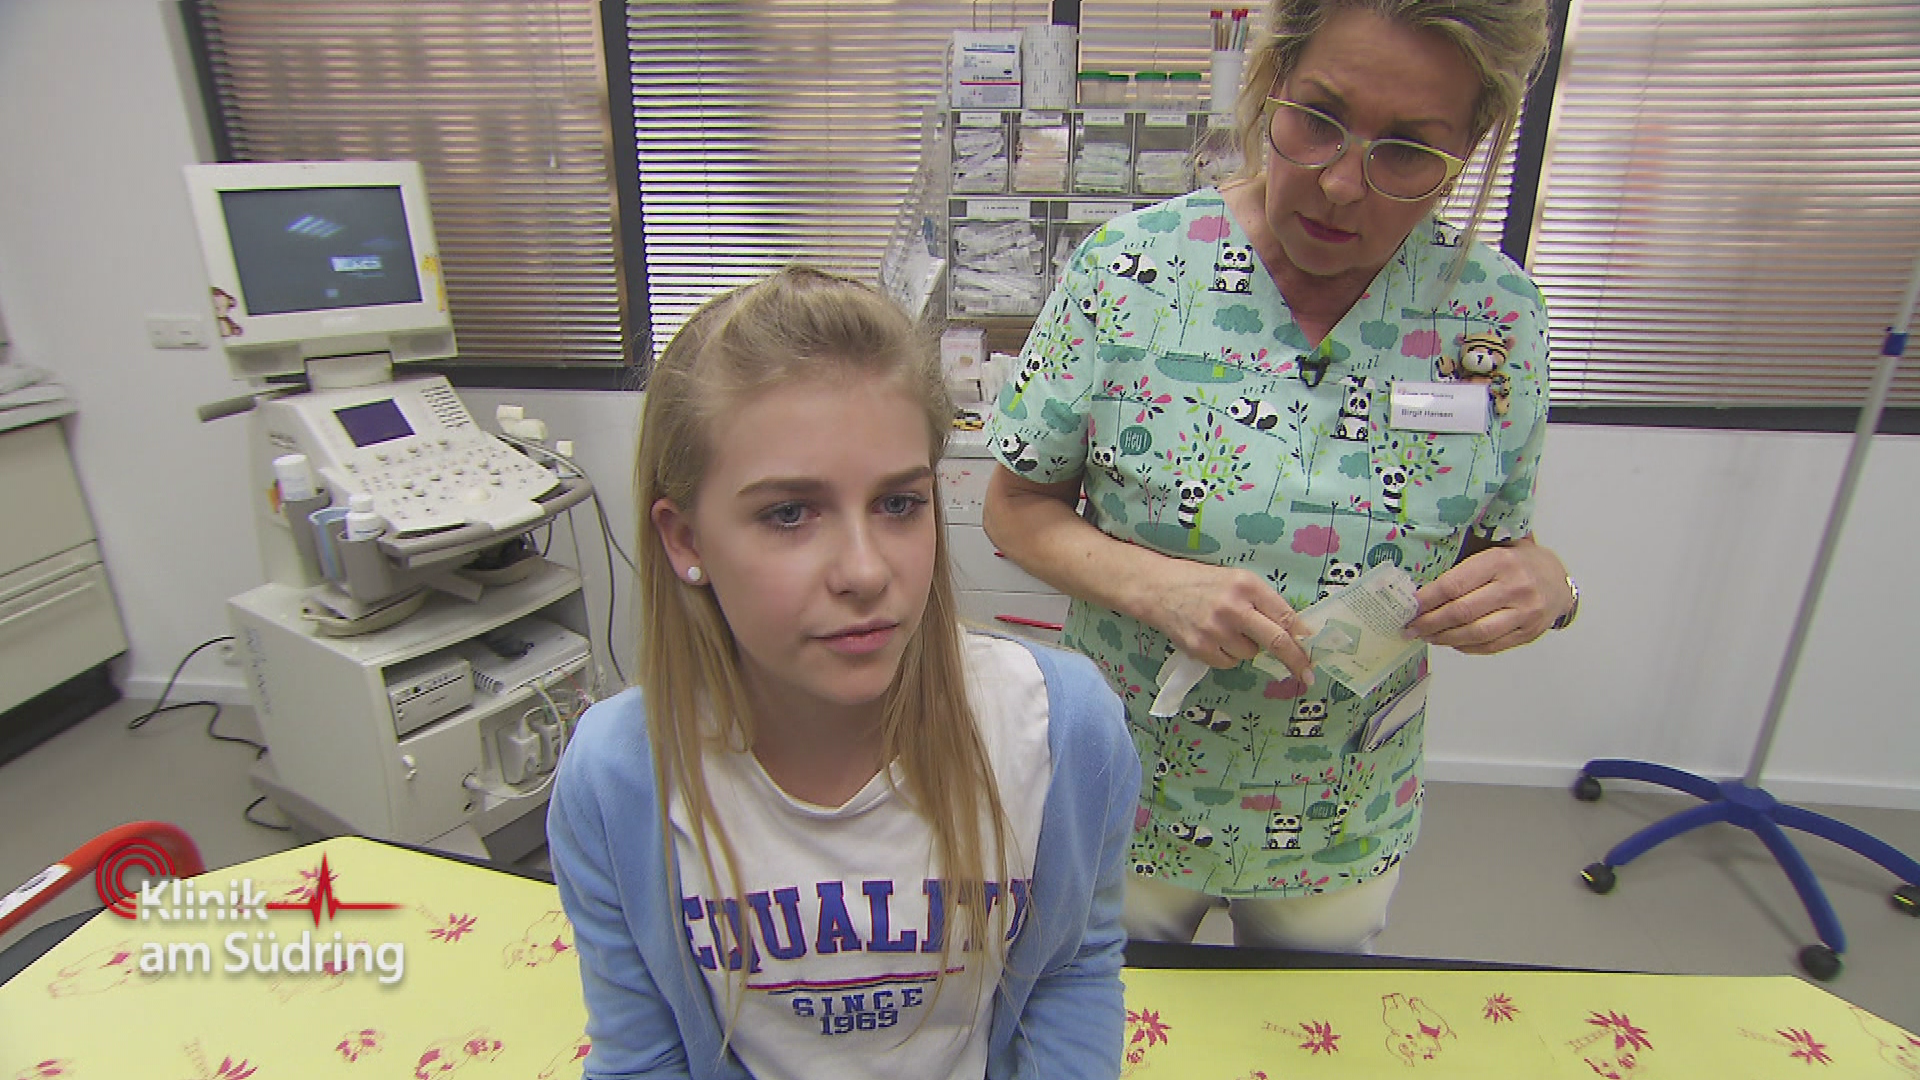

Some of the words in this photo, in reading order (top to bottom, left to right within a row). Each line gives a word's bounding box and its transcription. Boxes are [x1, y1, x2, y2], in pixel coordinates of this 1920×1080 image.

[1402, 409, 1423, 417] Birgit
[792, 987, 924, 1018] SINCE
[820, 1009, 898, 1036] 1969
